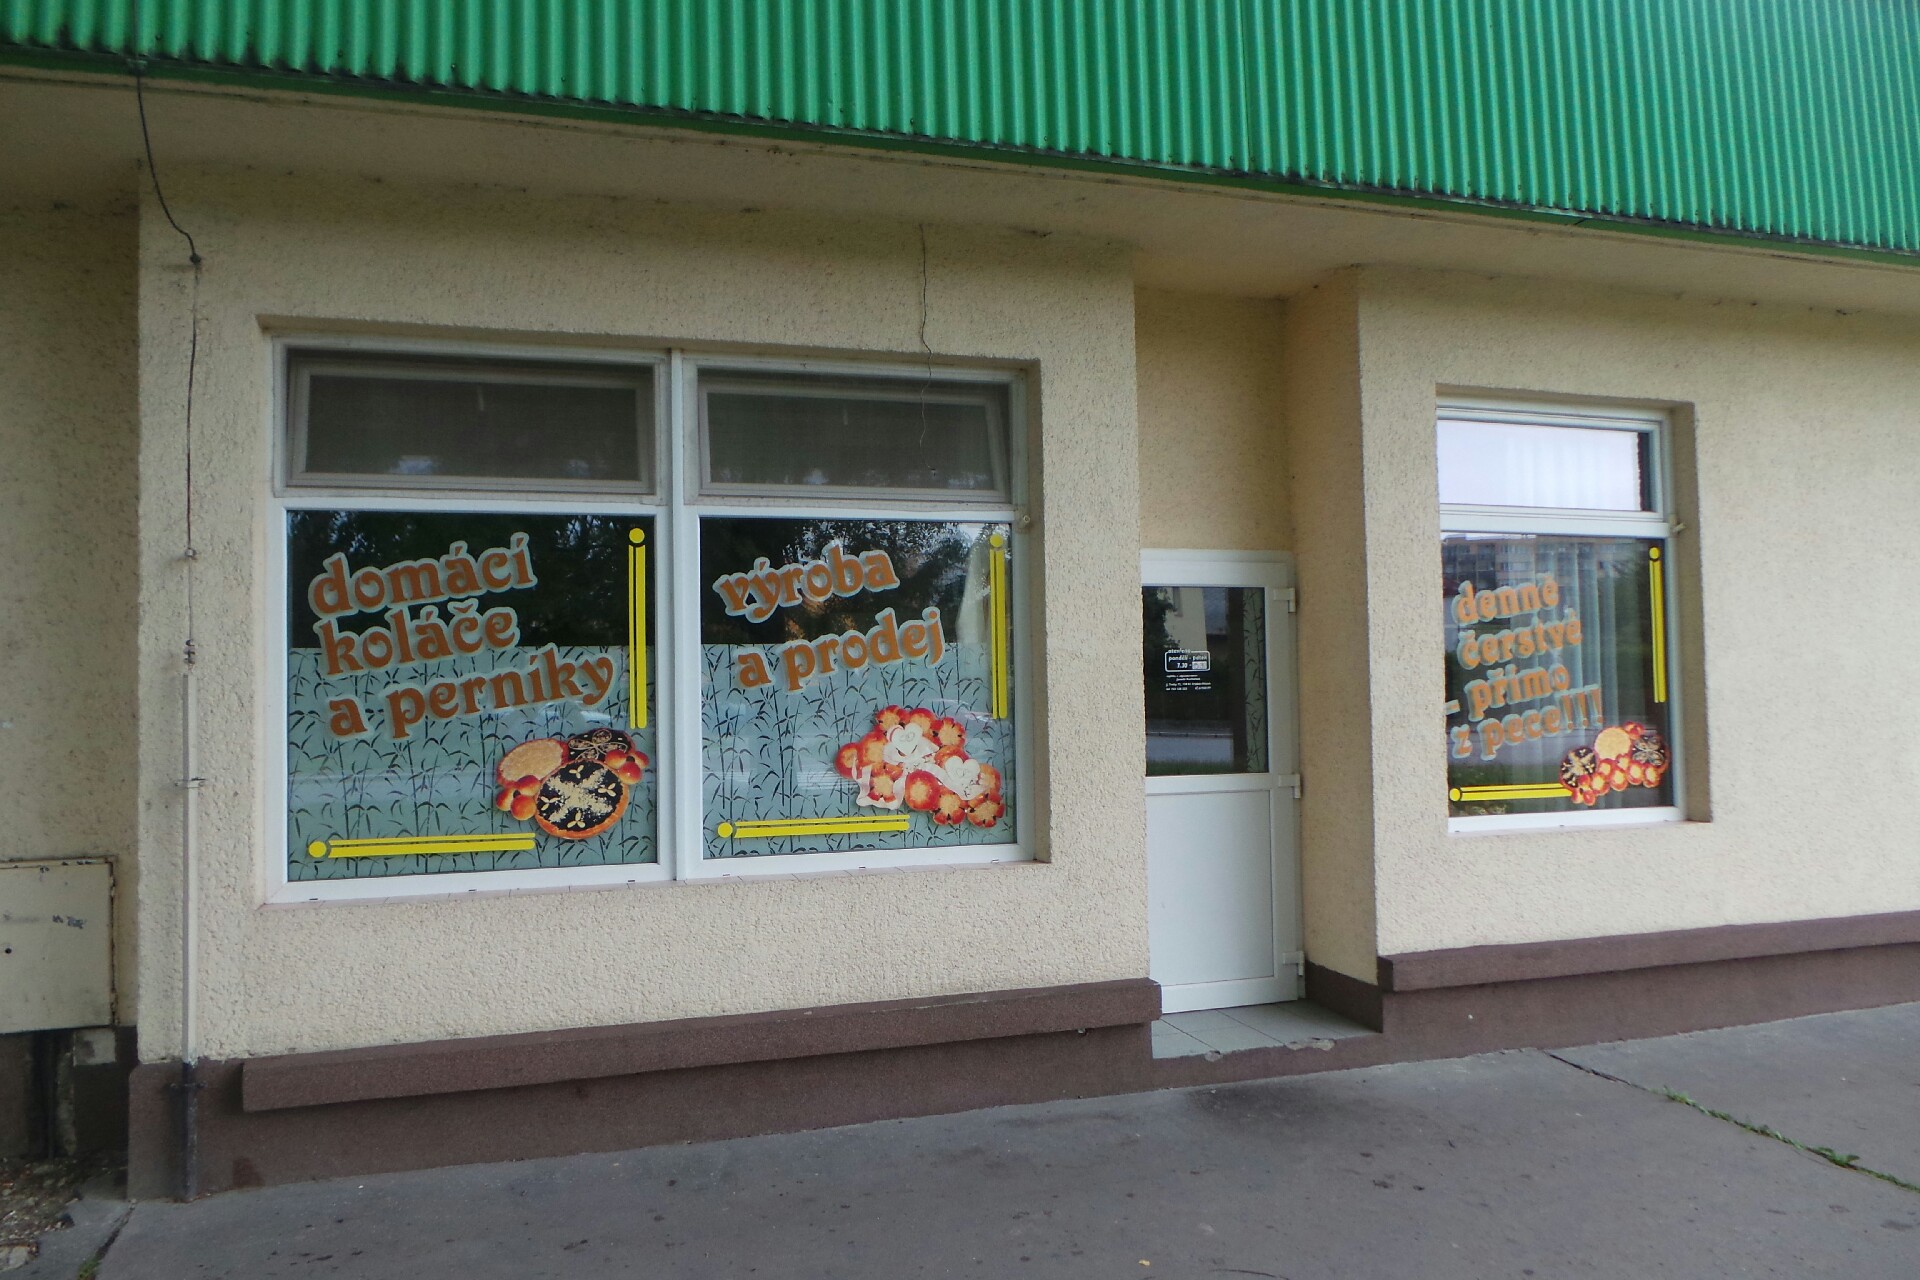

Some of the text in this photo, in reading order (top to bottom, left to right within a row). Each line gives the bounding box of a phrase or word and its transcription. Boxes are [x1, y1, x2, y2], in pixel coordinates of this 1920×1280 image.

[311, 535, 535, 614] domácí
[718, 544, 899, 619] výroba
[1456, 574, 1560, 623] denně
[317, 602, 517, 676] koláče
[738, 608, 944, 691] a prodej
[329, 647, 615, 739] a perníky
[1455, 686, 1605, 757] z pece!!!
[1469, 664, 1571, 719] přímo
